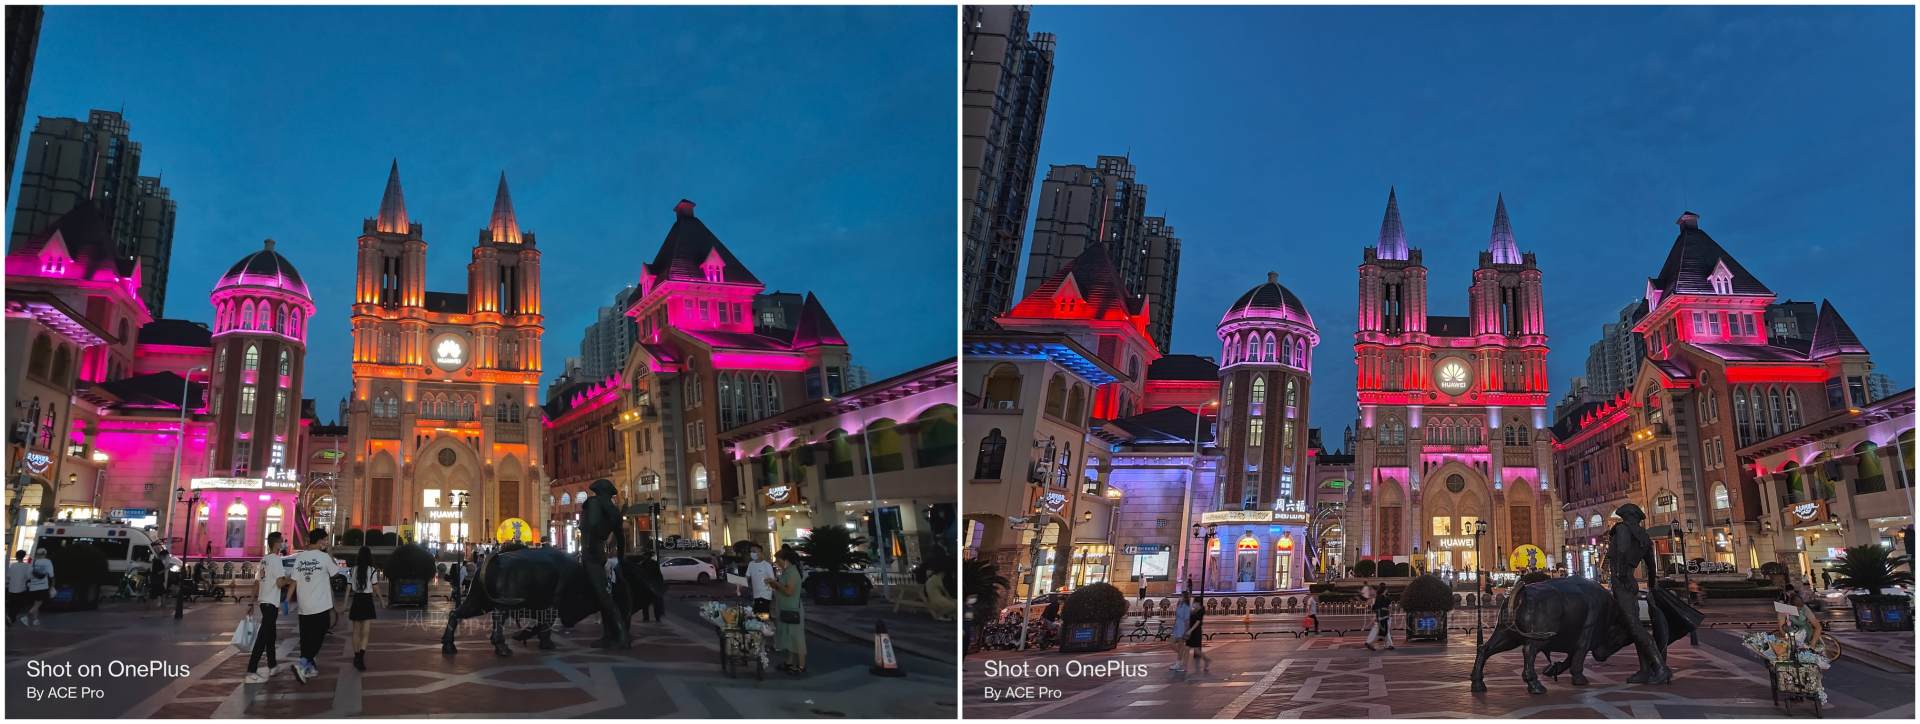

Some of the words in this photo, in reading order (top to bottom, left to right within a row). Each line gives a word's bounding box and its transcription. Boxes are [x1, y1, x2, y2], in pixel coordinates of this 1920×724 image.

[265, 467, 297, 481] 周六福
[1275, 498, 1306, 512] 周六福
[430, 510, 463, 519] HUAWEI
[1440, 538, 1474, 548] HUAWEI
